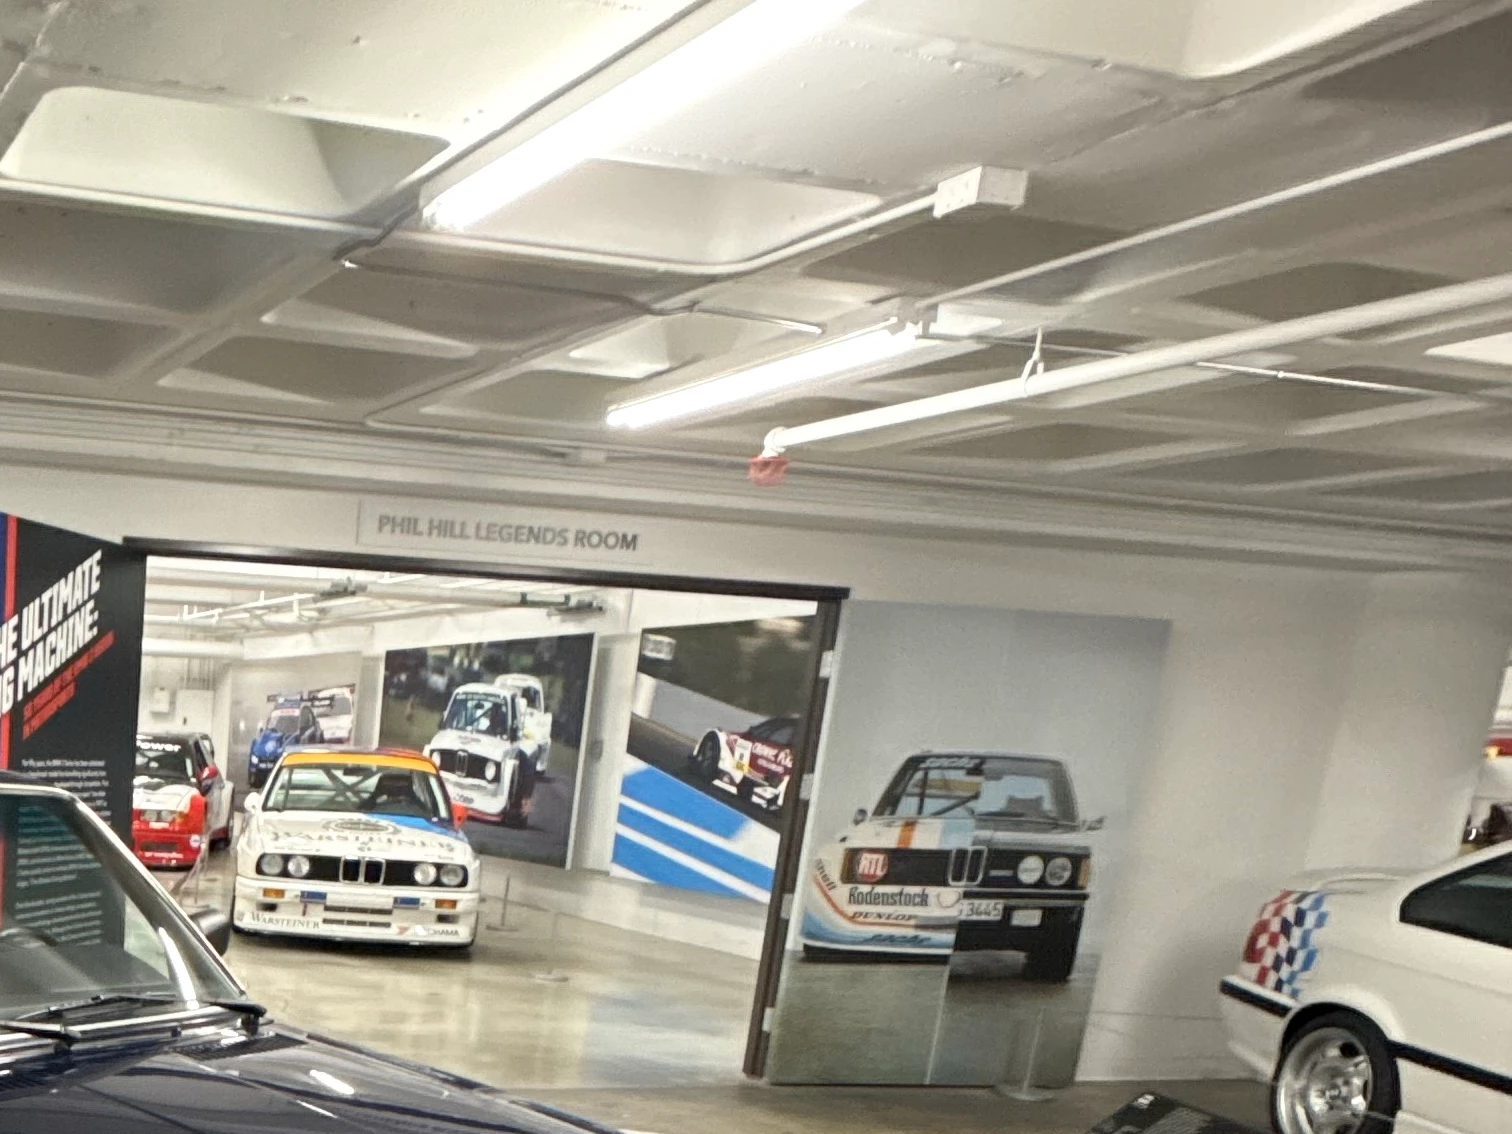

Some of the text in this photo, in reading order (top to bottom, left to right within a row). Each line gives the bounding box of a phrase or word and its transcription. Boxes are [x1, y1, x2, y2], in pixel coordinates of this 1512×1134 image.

[377, 514, 639, 551] PHIL HILL LEGENDS ROOM
[21, 548, 102, 651] ULTIMATE
[17, 599, 99, 702] MACHINE:
[847, 885, 930, 907] Rodenstock
